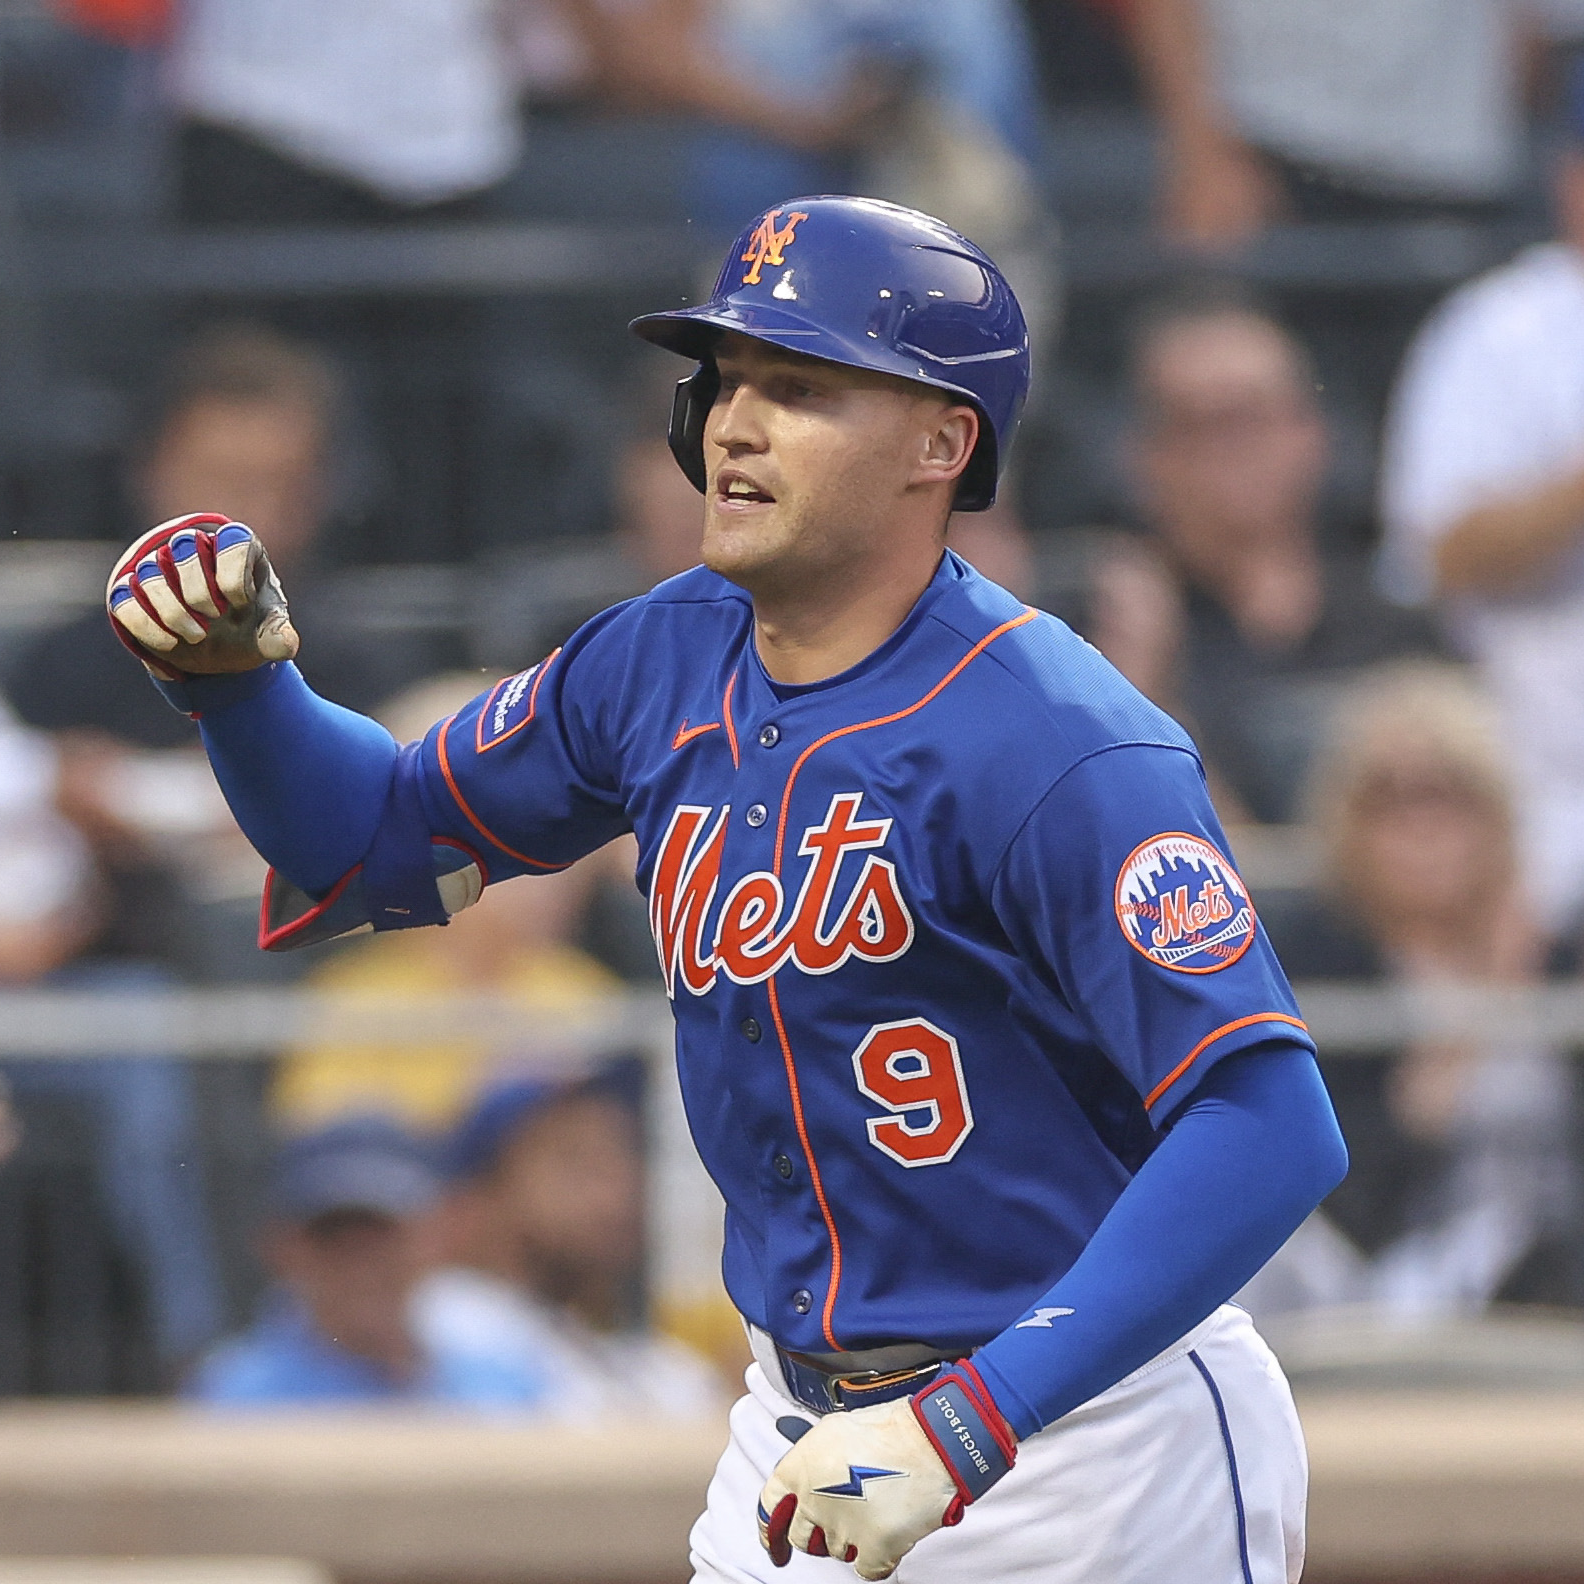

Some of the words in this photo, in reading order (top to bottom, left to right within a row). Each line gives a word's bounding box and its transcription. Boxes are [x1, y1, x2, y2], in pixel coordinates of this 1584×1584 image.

[649, 792, 915, 1000] Mets
[1152, 879, 1234, 948] Mets
[852, 1016, 975, 1169] 9
[935, 1396, 962, 1427] BOLT
[958, 1432, 990, 1474] BRUCE
